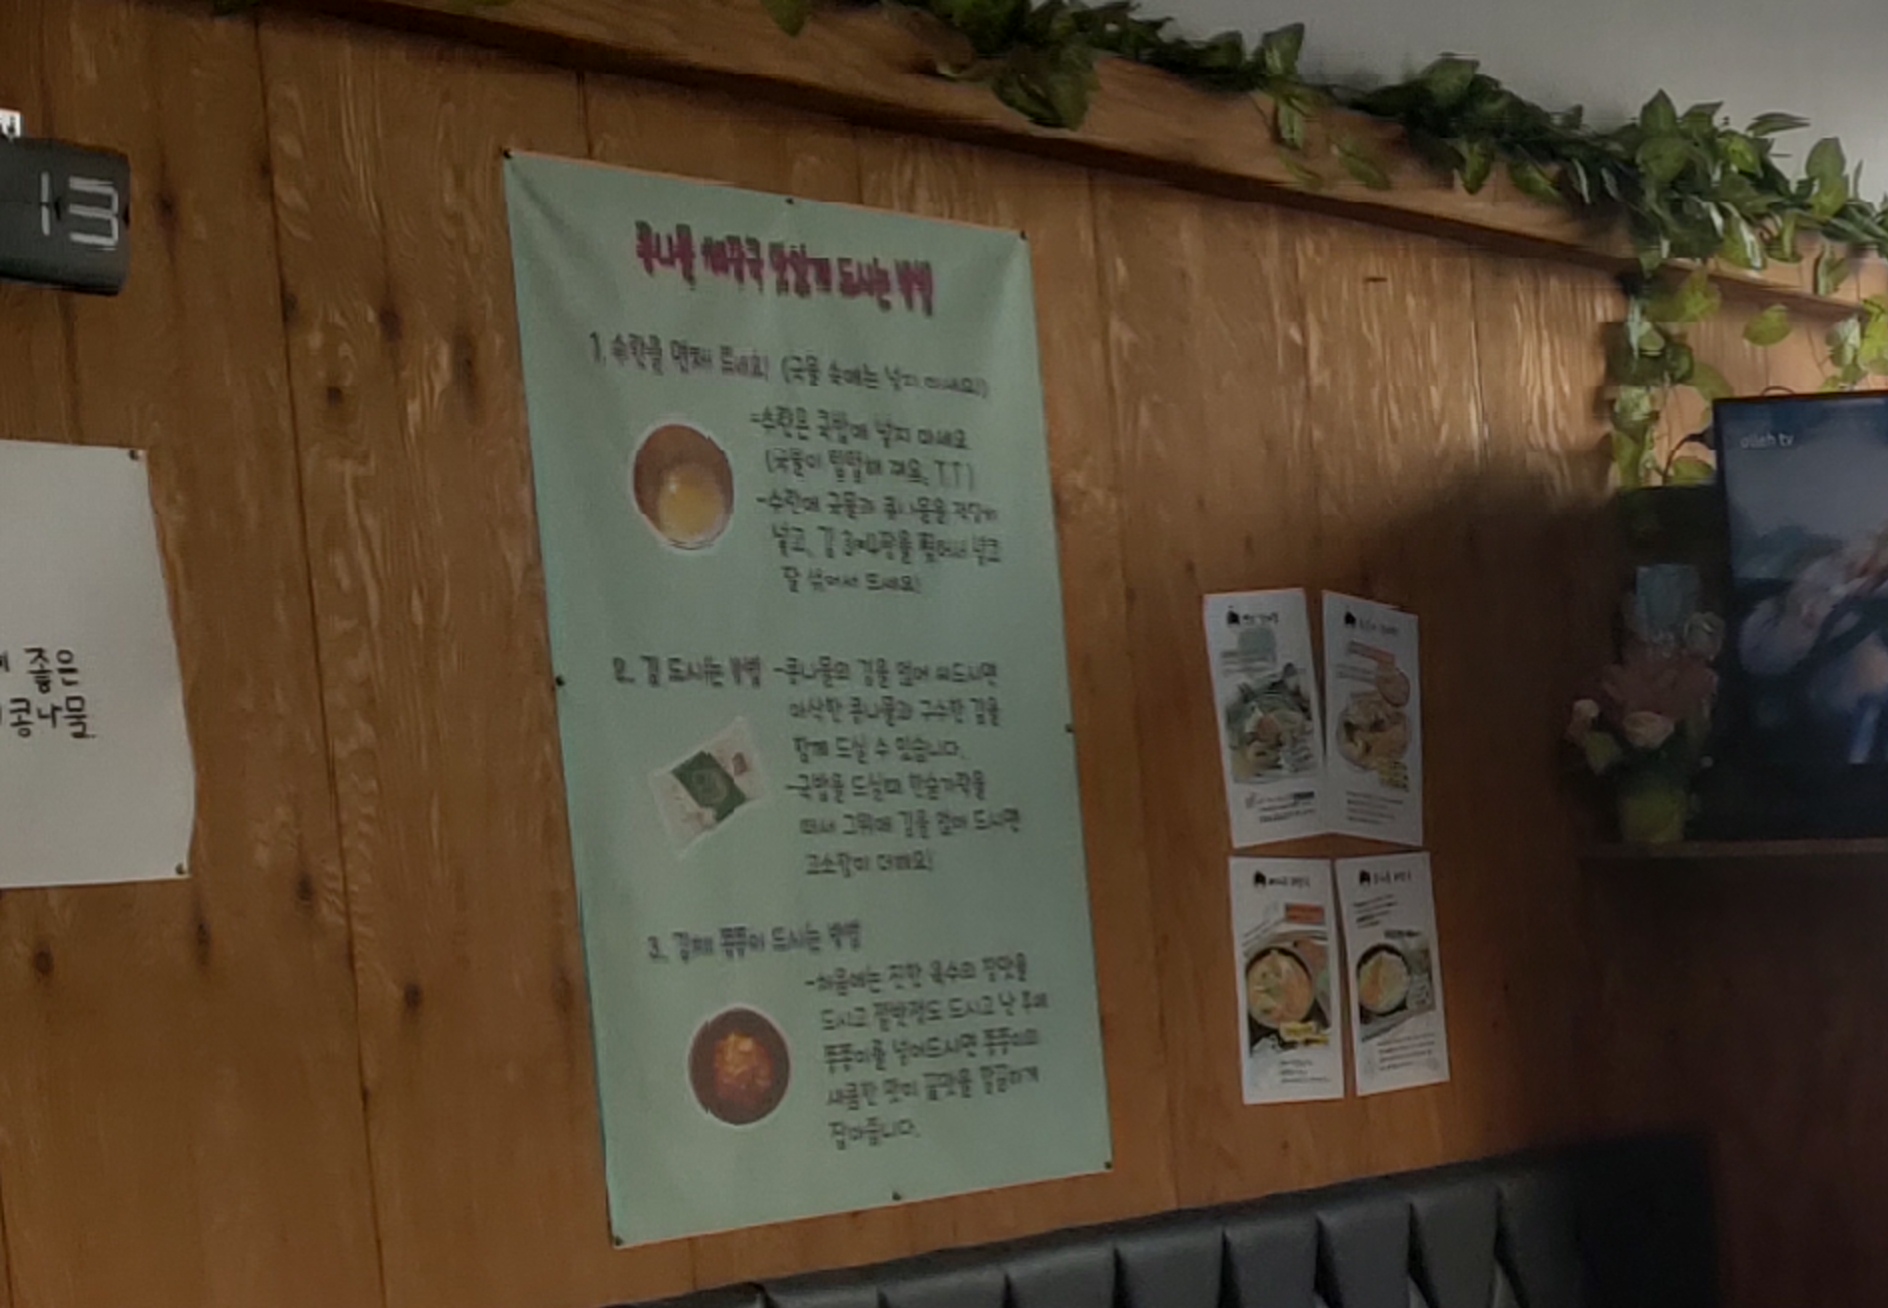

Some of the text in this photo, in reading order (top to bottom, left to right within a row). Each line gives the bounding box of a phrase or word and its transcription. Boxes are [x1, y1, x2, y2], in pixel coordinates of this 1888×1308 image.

[816, 525, 837, 559] 김
[24, 648, 79, 694] 좋은
[9, 693, 96, 738] 콩나물
[873, 736, 890, 761] 수
